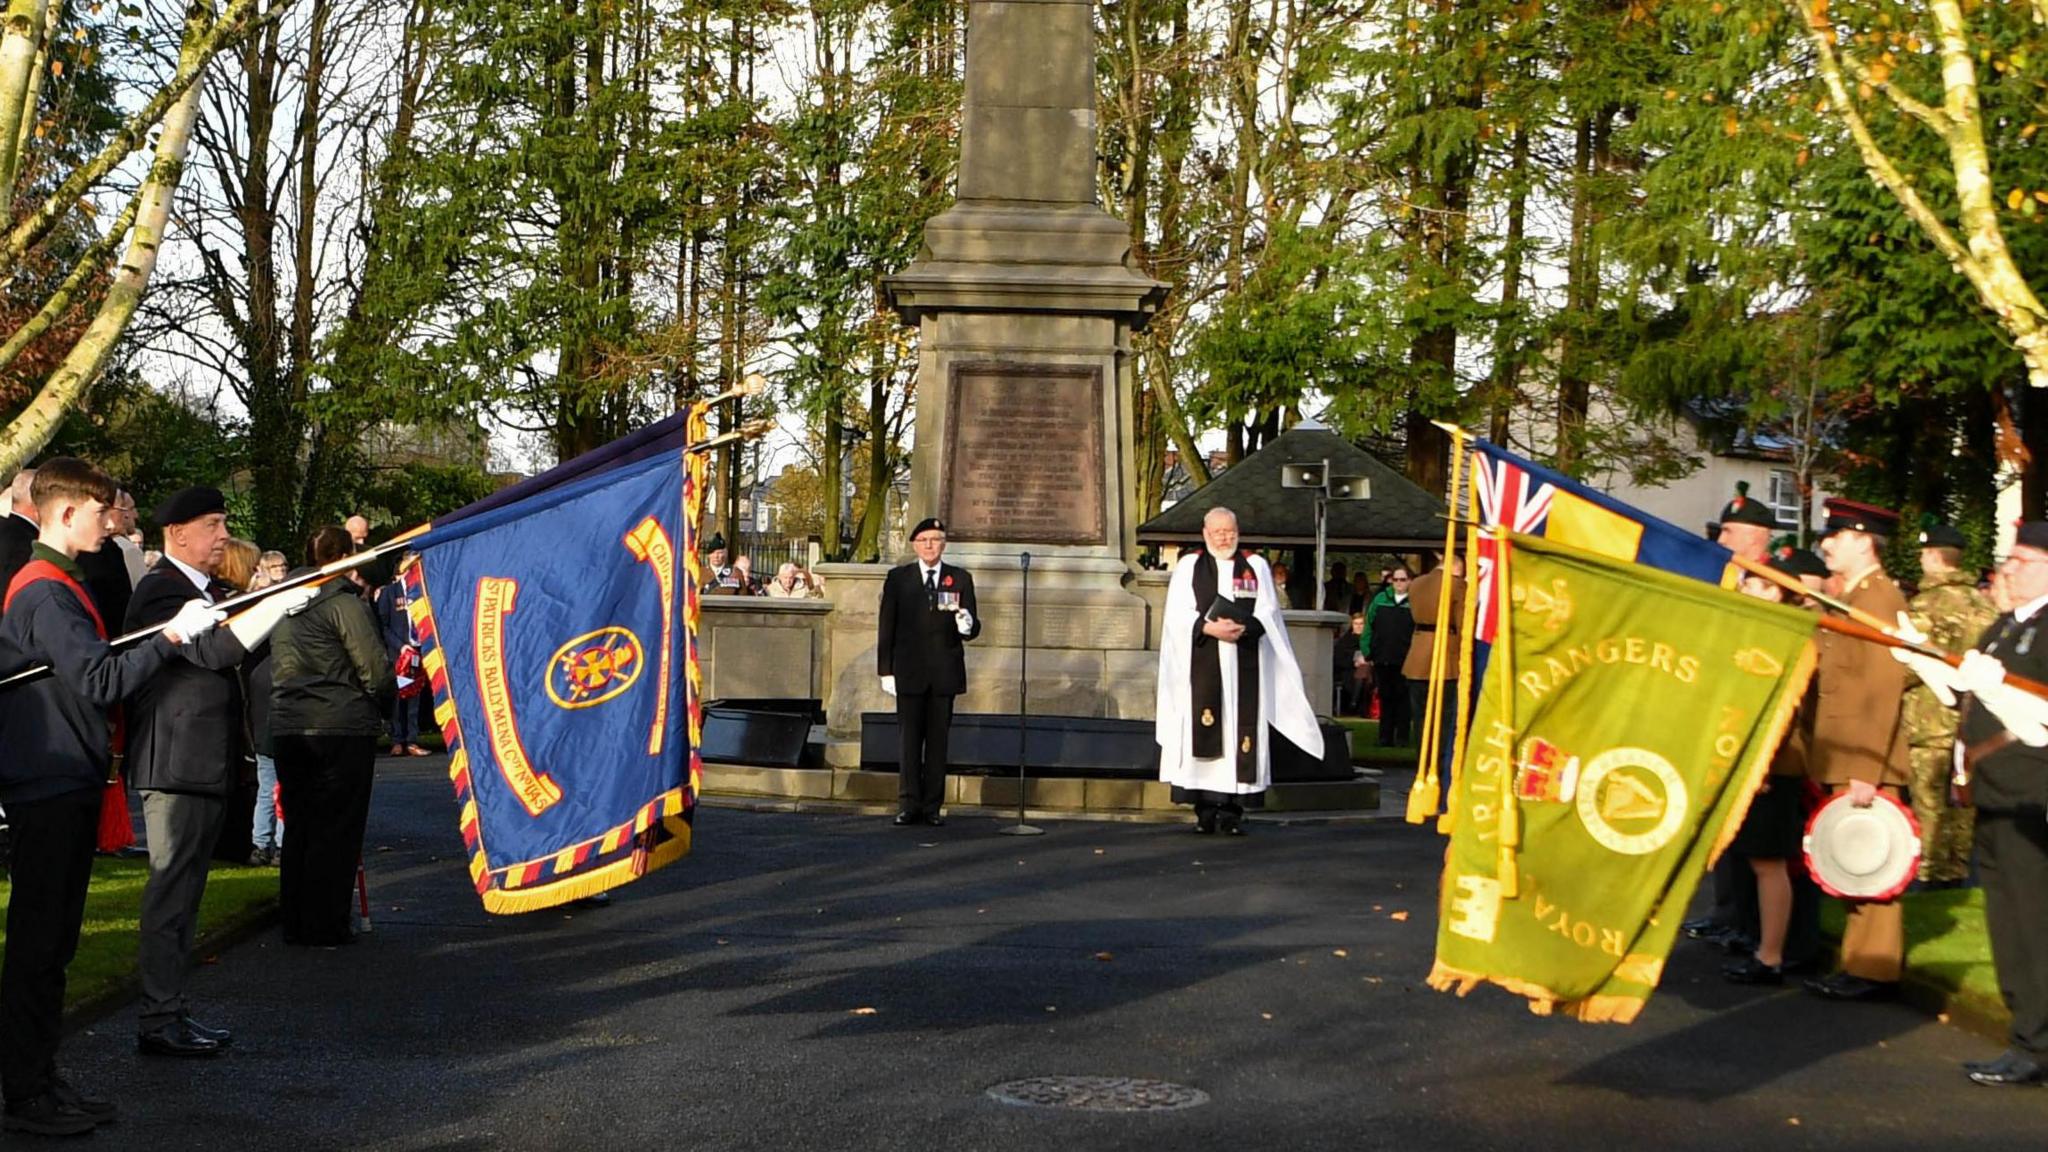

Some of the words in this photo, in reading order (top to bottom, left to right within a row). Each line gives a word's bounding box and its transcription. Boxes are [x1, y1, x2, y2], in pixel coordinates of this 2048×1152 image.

[485, 667, 513, 749] BALLYMENA
[1472, 720, 1516, 842] IRISH
[1520, 637, 1700, 699] RANGERS
